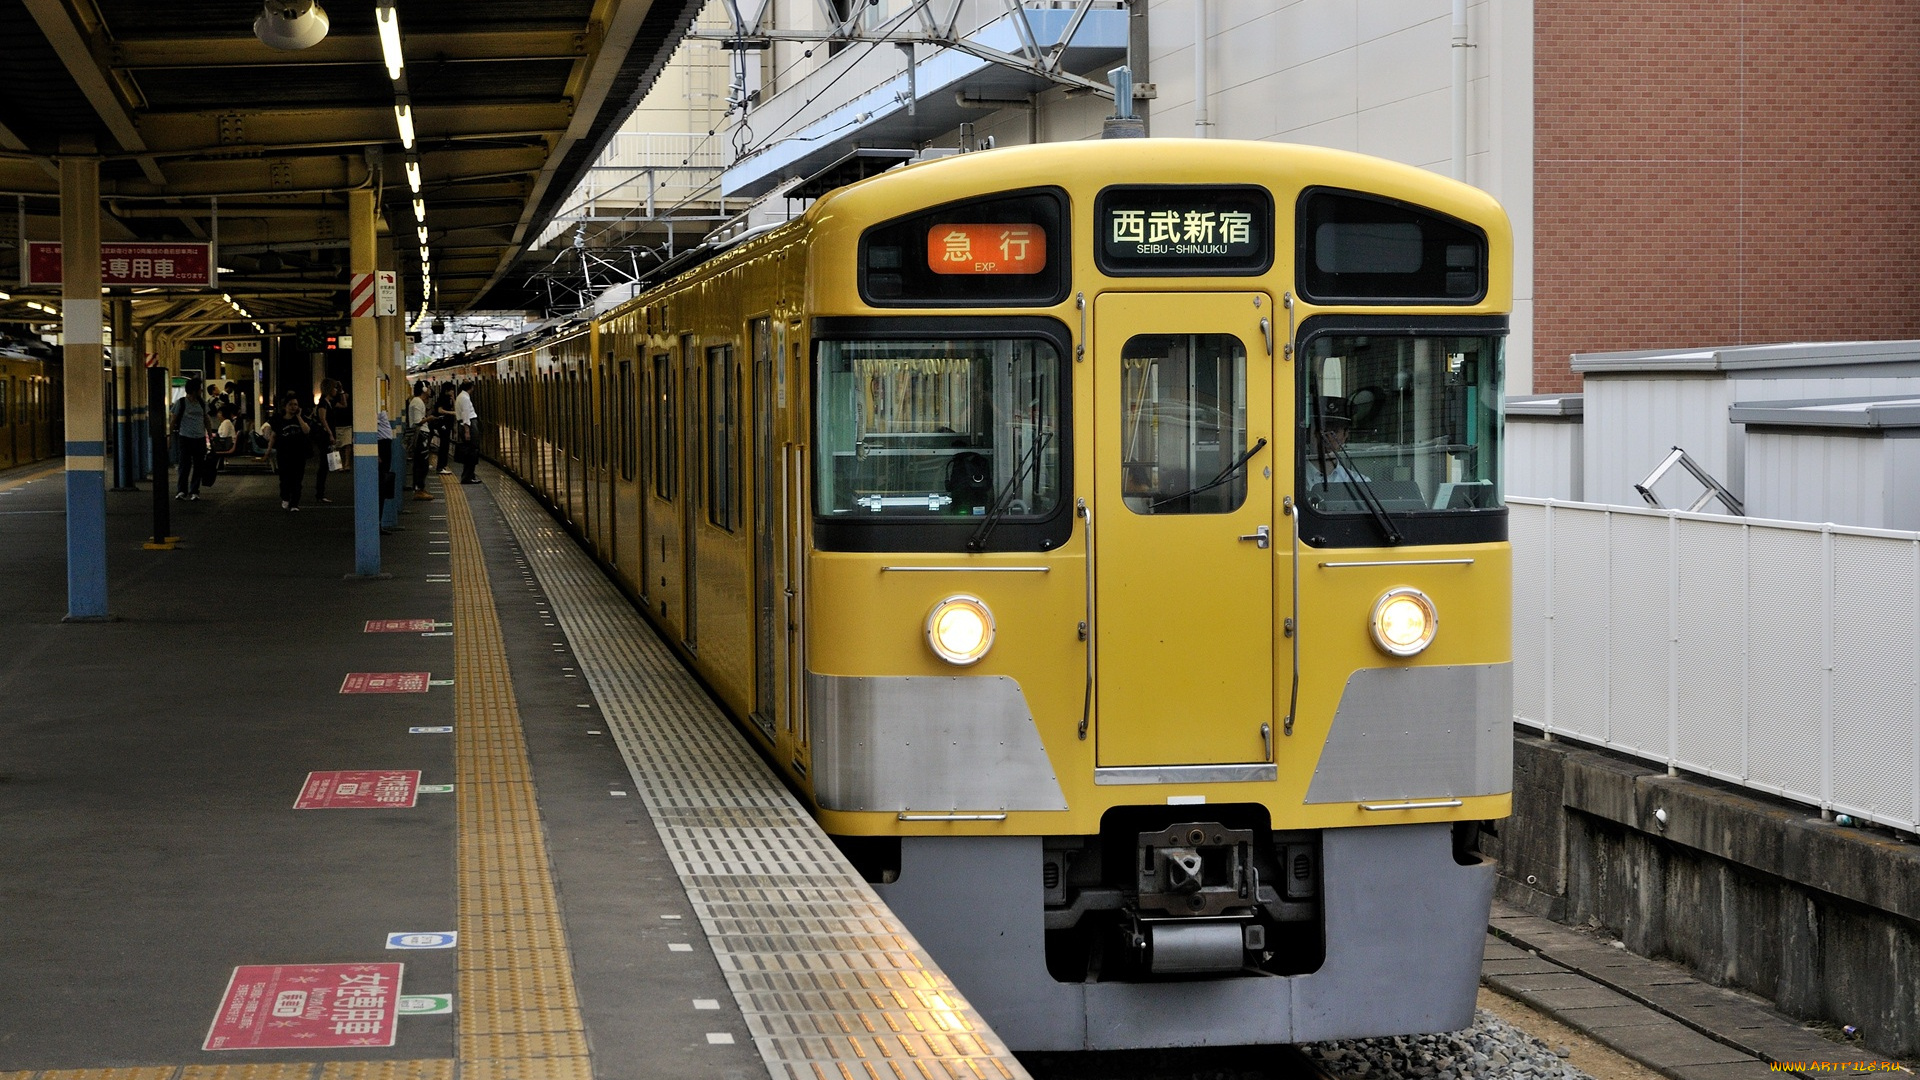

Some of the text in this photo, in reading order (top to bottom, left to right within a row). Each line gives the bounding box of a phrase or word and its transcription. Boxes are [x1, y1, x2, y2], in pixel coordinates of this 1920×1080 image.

[1112, 210, 1252, 244] 西武新宿
[1136, 244, 1228, 254] SEIBU-SHINJUKU
[975, 262, 998, 272] EXP.
[328, 973, 390, 1035] 女性専用車
